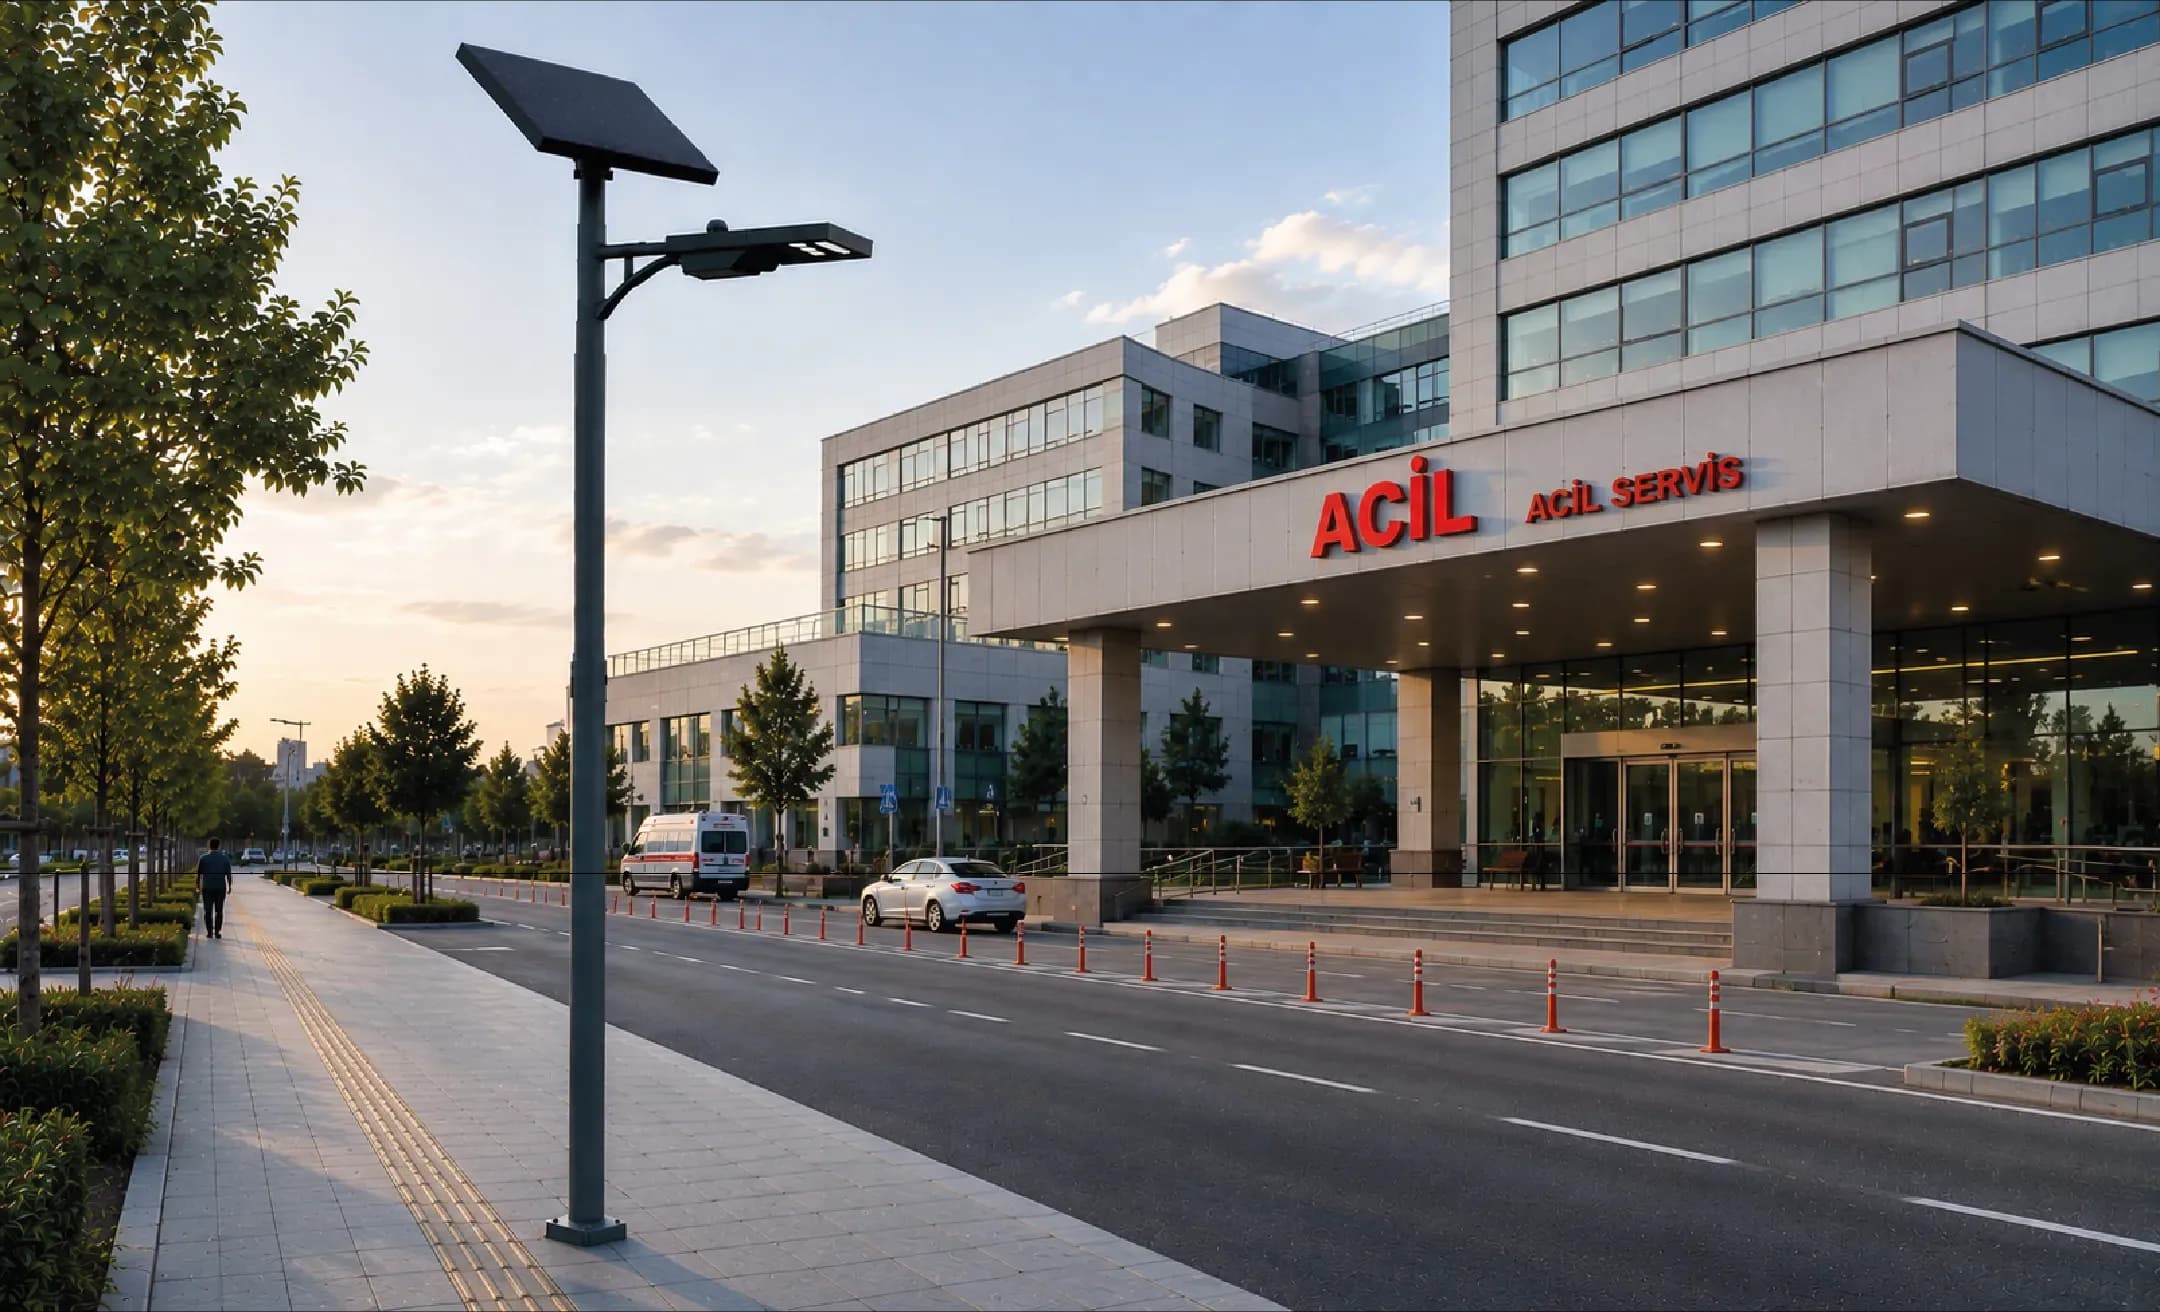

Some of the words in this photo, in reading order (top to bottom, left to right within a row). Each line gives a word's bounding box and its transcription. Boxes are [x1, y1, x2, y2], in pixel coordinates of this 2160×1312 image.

[1311, 455, 1477, 558] ACİL
[1525, 479, 1603, 523] ACİL
[1611, 452, 1744, 508] SERVİS
